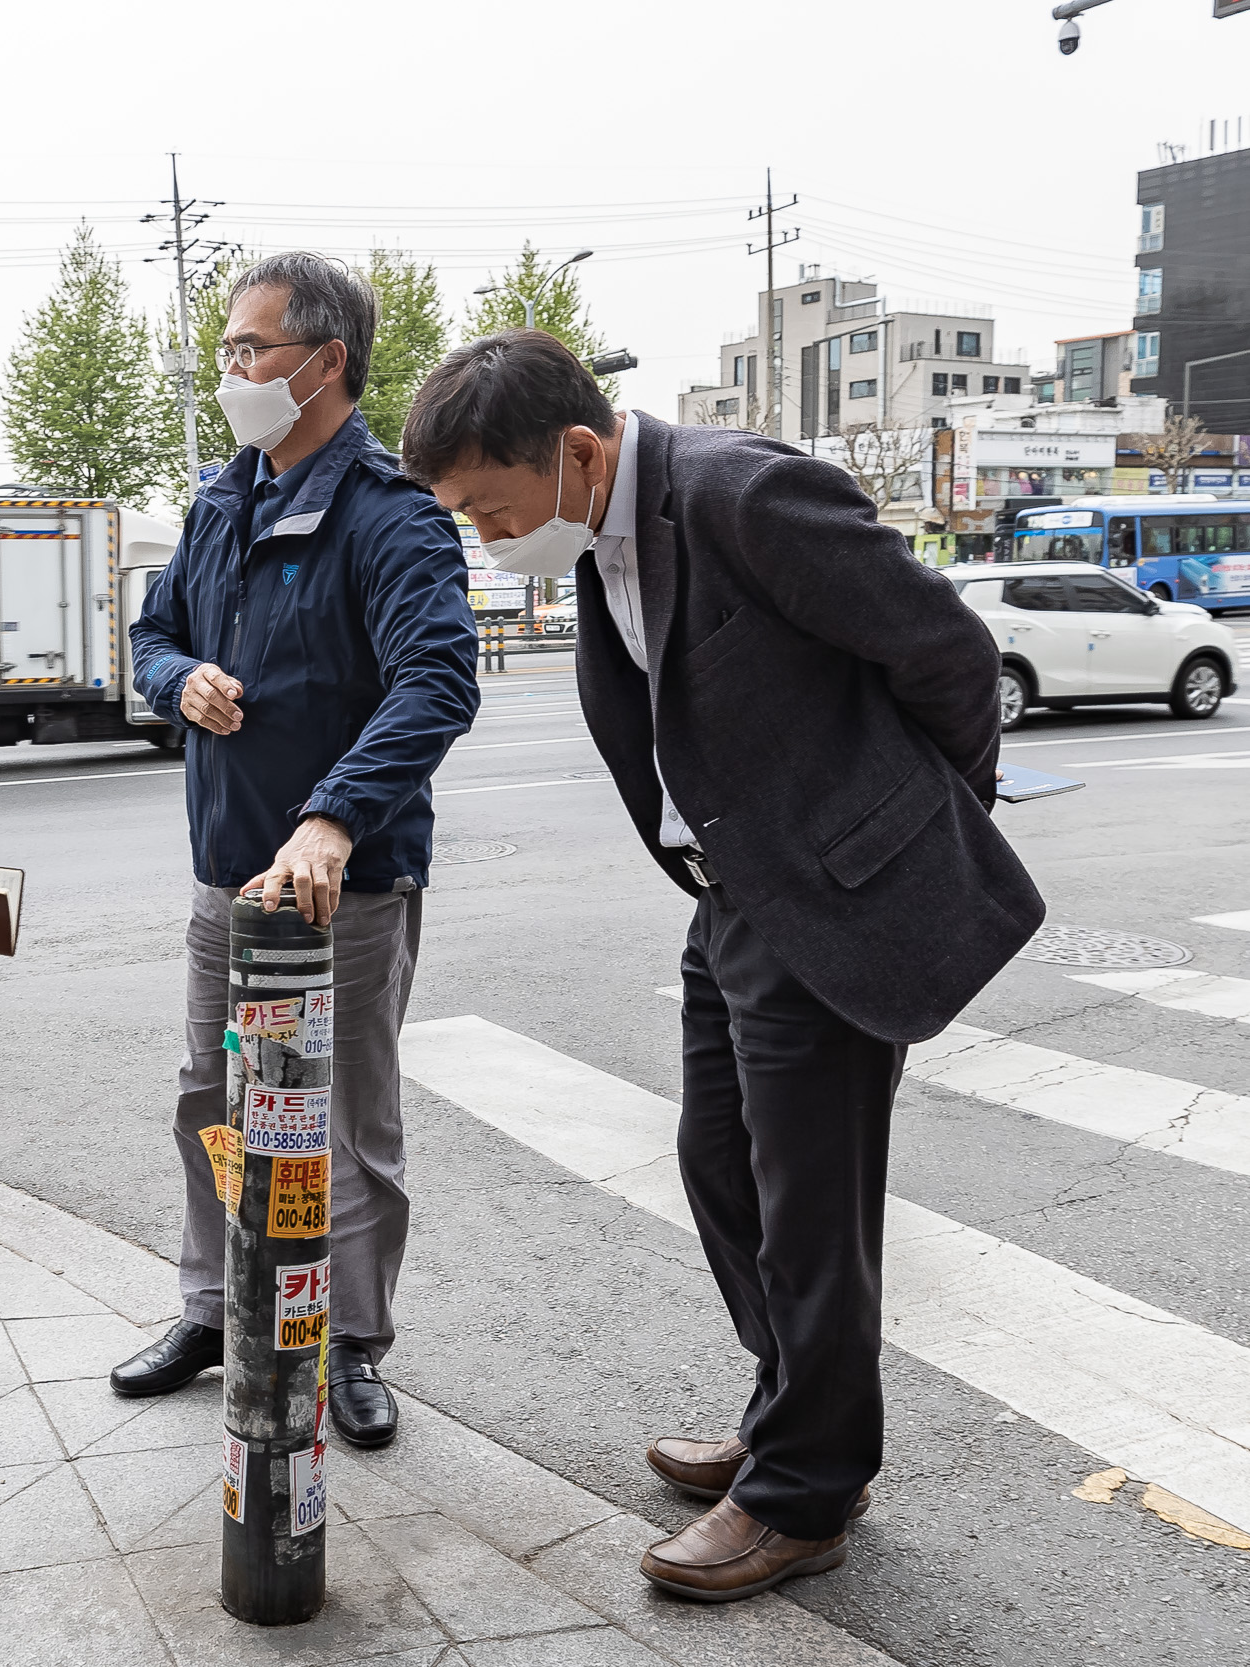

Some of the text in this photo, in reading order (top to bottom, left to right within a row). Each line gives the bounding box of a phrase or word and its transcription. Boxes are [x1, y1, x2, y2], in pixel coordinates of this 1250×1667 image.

[240, 1003, 296, 1029] 카드
[253, 1093, 305, 1112] 카드
[206, 1128, 236, 1155] 카드
[284, 1301, 324, 1318] 카드한도
